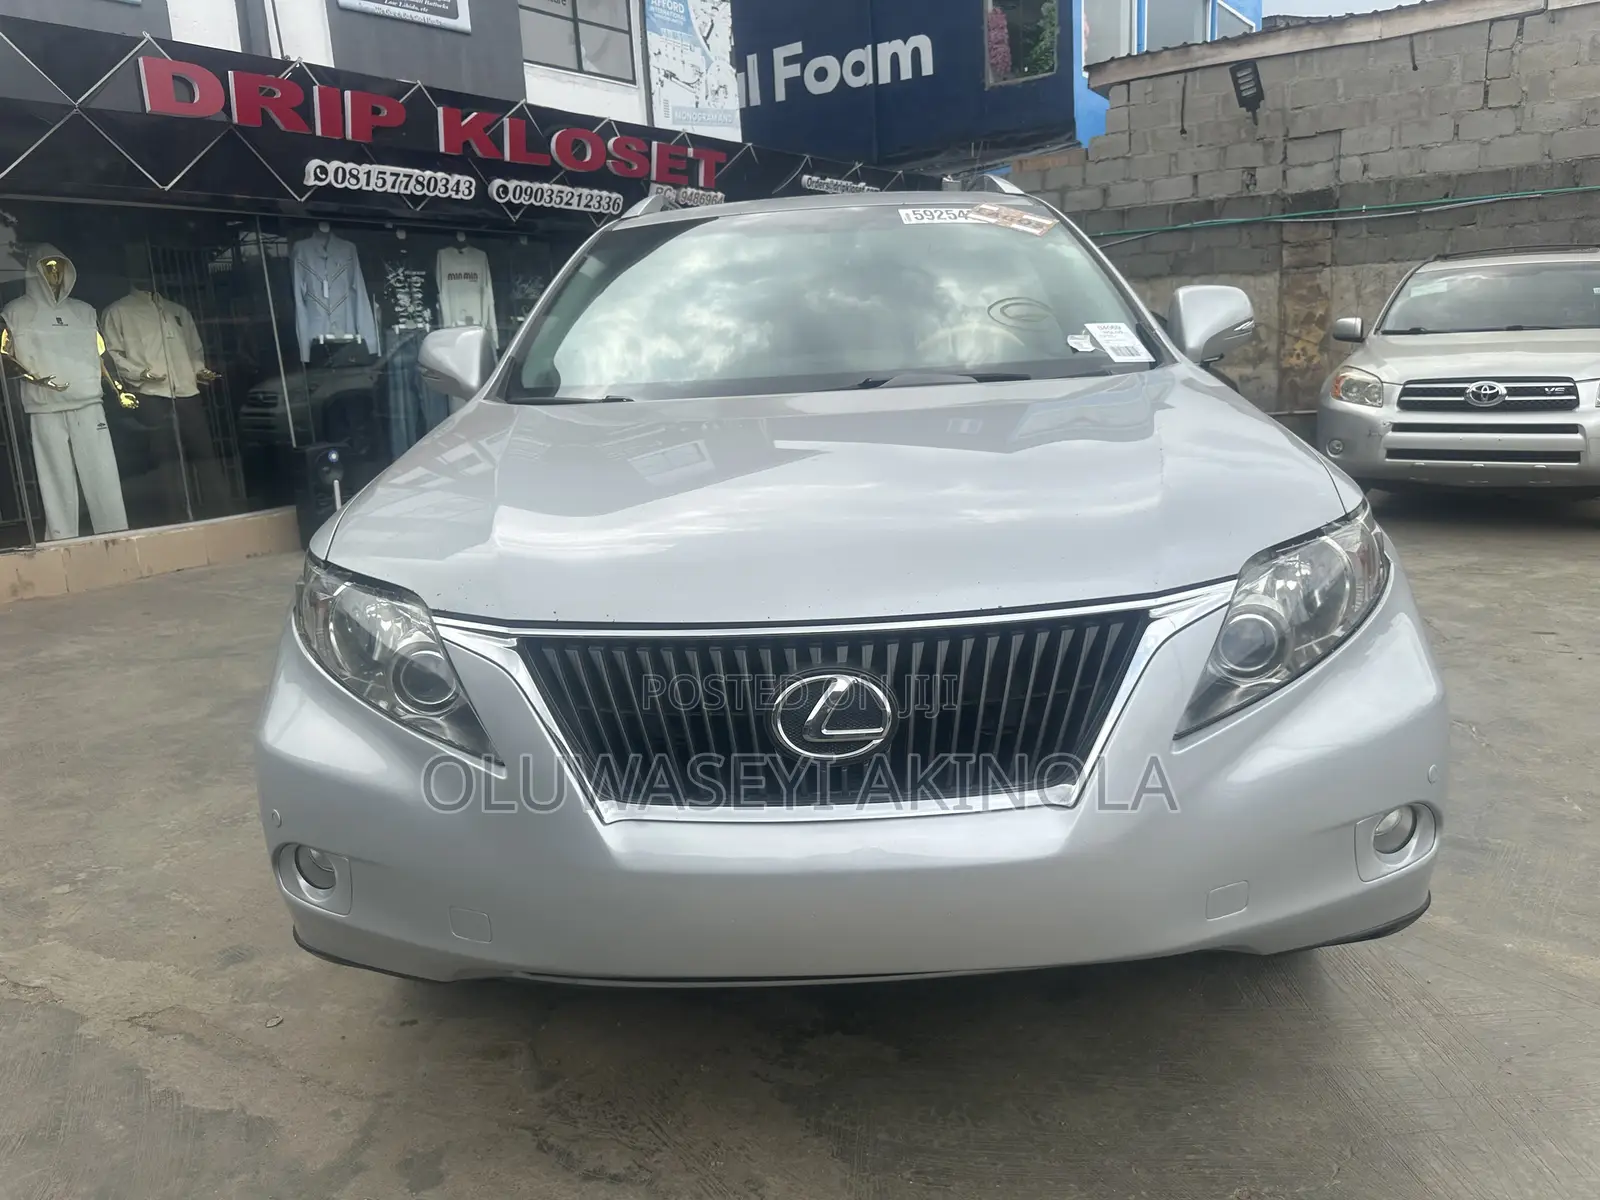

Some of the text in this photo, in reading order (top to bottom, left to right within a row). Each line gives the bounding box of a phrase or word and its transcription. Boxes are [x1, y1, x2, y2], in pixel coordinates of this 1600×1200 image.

[773, 34, 934, 103] Foam
[138, 56, 727, 189] DRIP KLOSET
[333, 166, 474, 197] 08157780343
[512, 184, 621, 213] 09035212336
